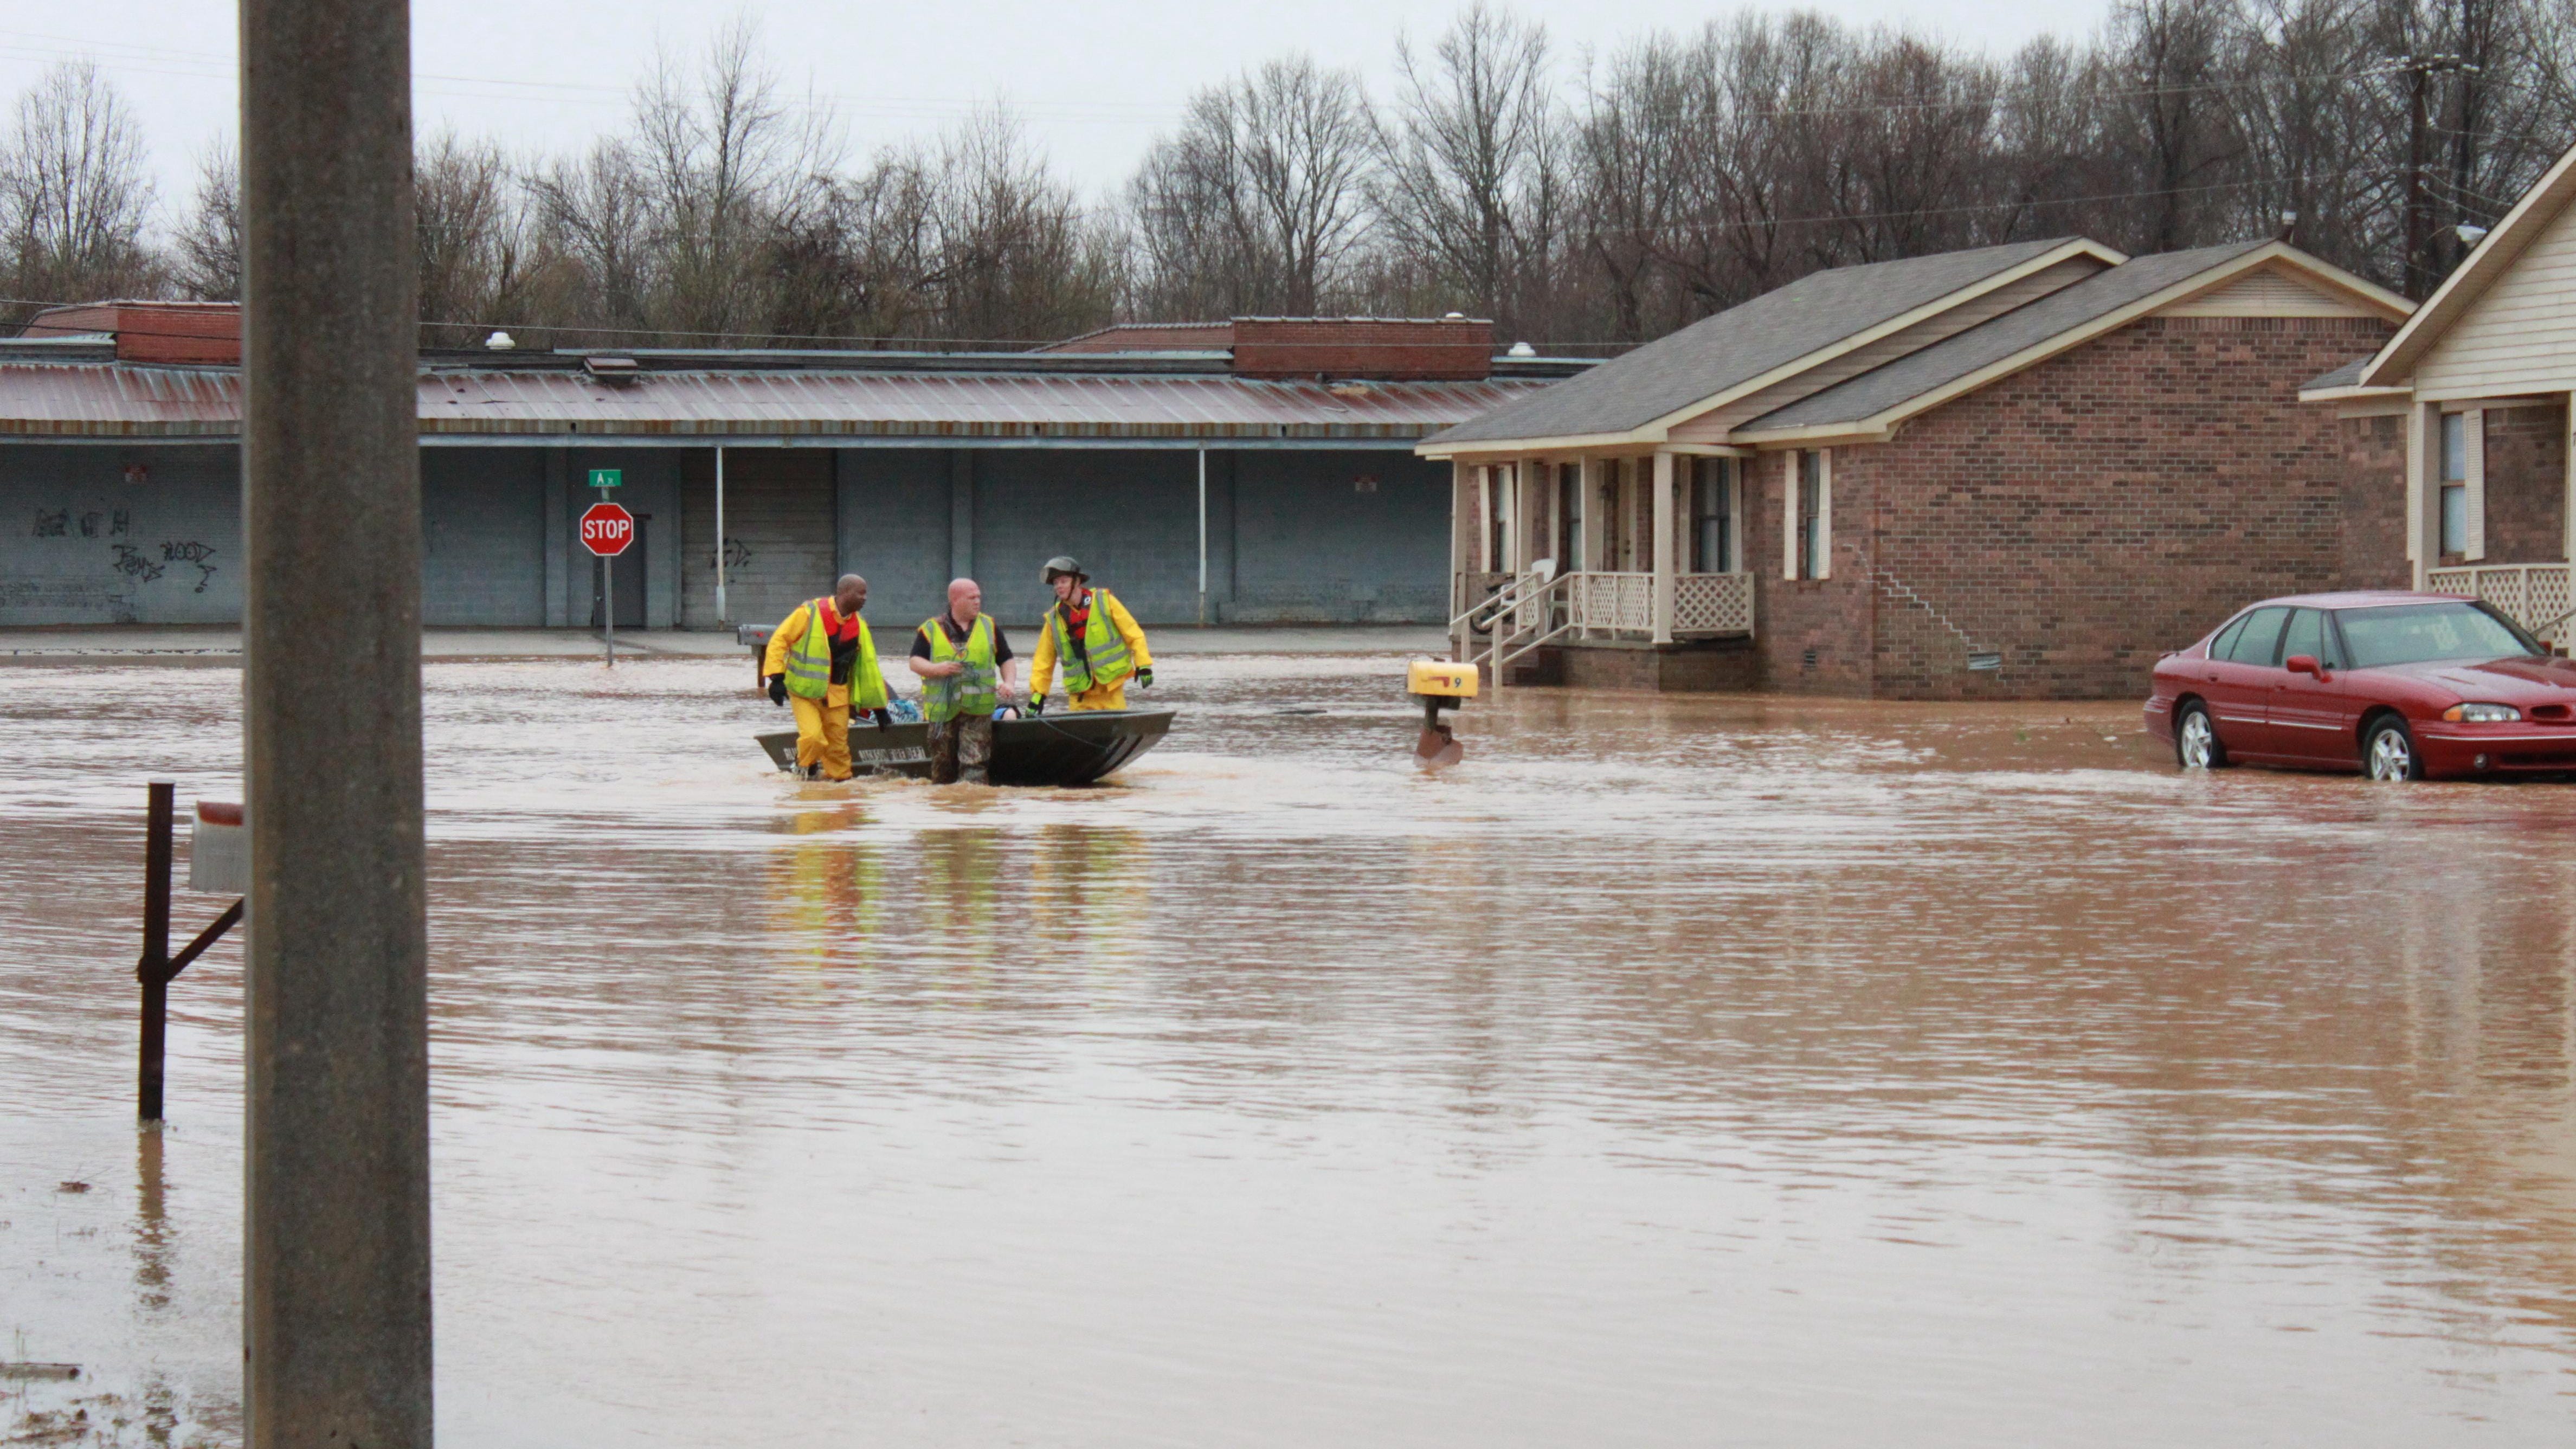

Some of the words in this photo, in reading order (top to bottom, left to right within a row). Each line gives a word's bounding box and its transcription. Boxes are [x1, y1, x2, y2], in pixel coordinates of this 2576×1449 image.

[597, 472, 604, 484] A
[584, 519, 629, 539] STOP
[1454, 677, 1461, 688] 9
[905, 746, 926, 760] DEPT
